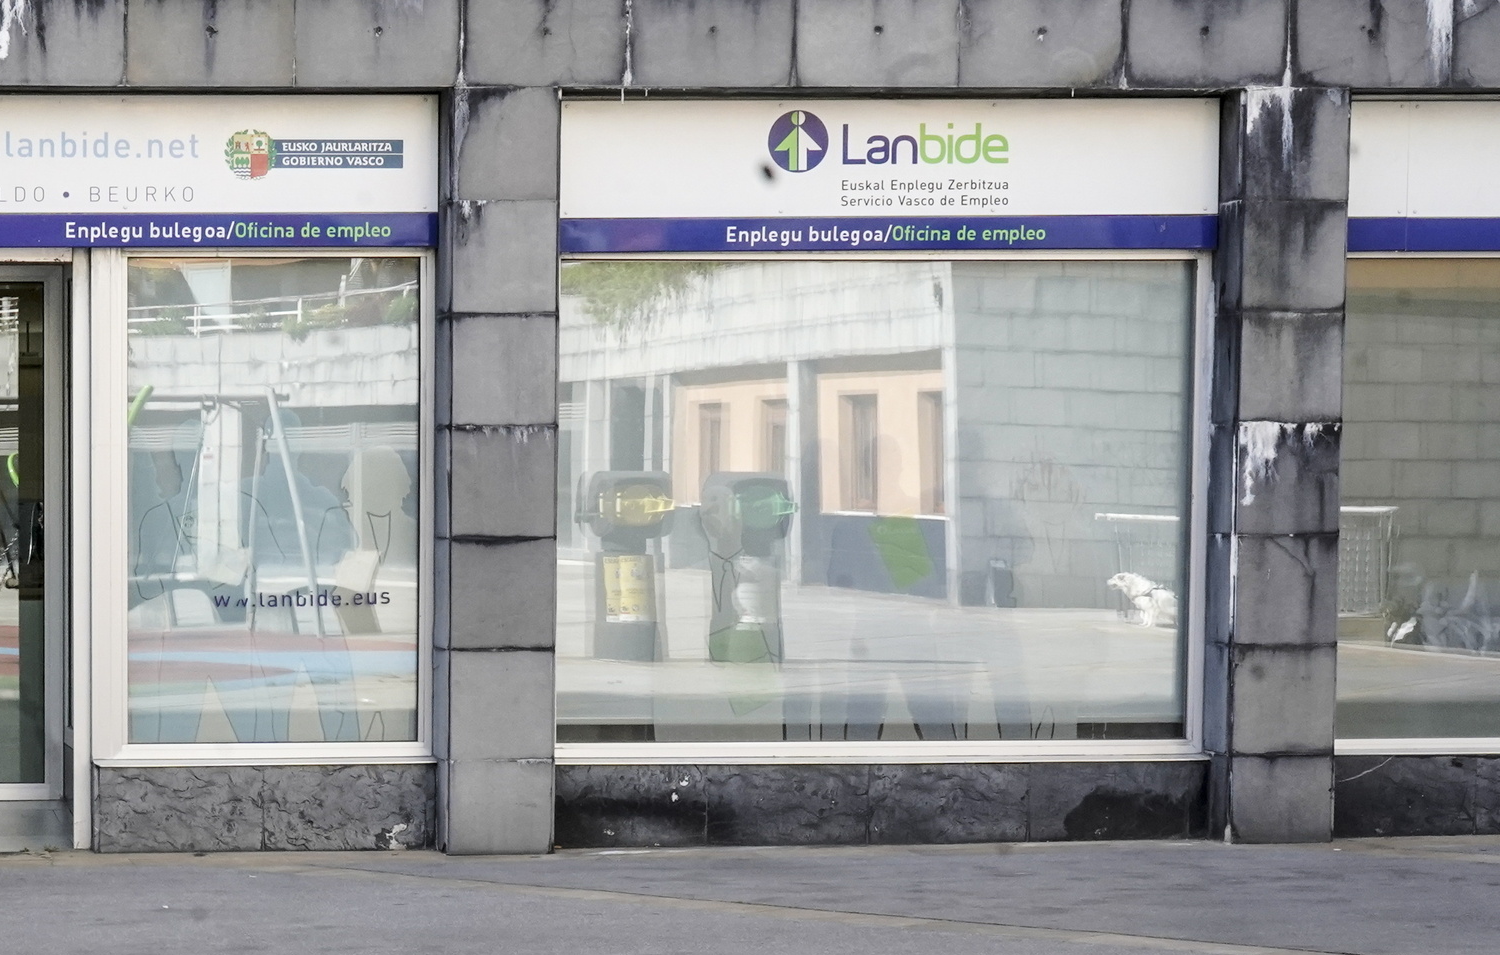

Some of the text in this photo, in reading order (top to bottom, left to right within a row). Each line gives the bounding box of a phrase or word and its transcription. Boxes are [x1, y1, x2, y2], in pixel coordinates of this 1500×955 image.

[282, 142, 392, 153] EUSKO JAURLARITZA
[842, 122, 1009, 165] Lanbide
[282, 156, 384, 166] GOBIERNO VASCO
[841, 179, 1009, 193] Euskal Enplegu Zerbitzua
[88, 186, 195, 203] BEURKO
[840, 195, 1009, 208] Servicio Vasco de Empleo
[65, 221, 143, 243] Enplegu
[301, 221, 321, 239] de
[326, 221, 392, 242] empleo
[726, 225, 802, 247] Enplegu
[956, 225, 977, 241] de
[982, 224, 1046, 246] empleo
